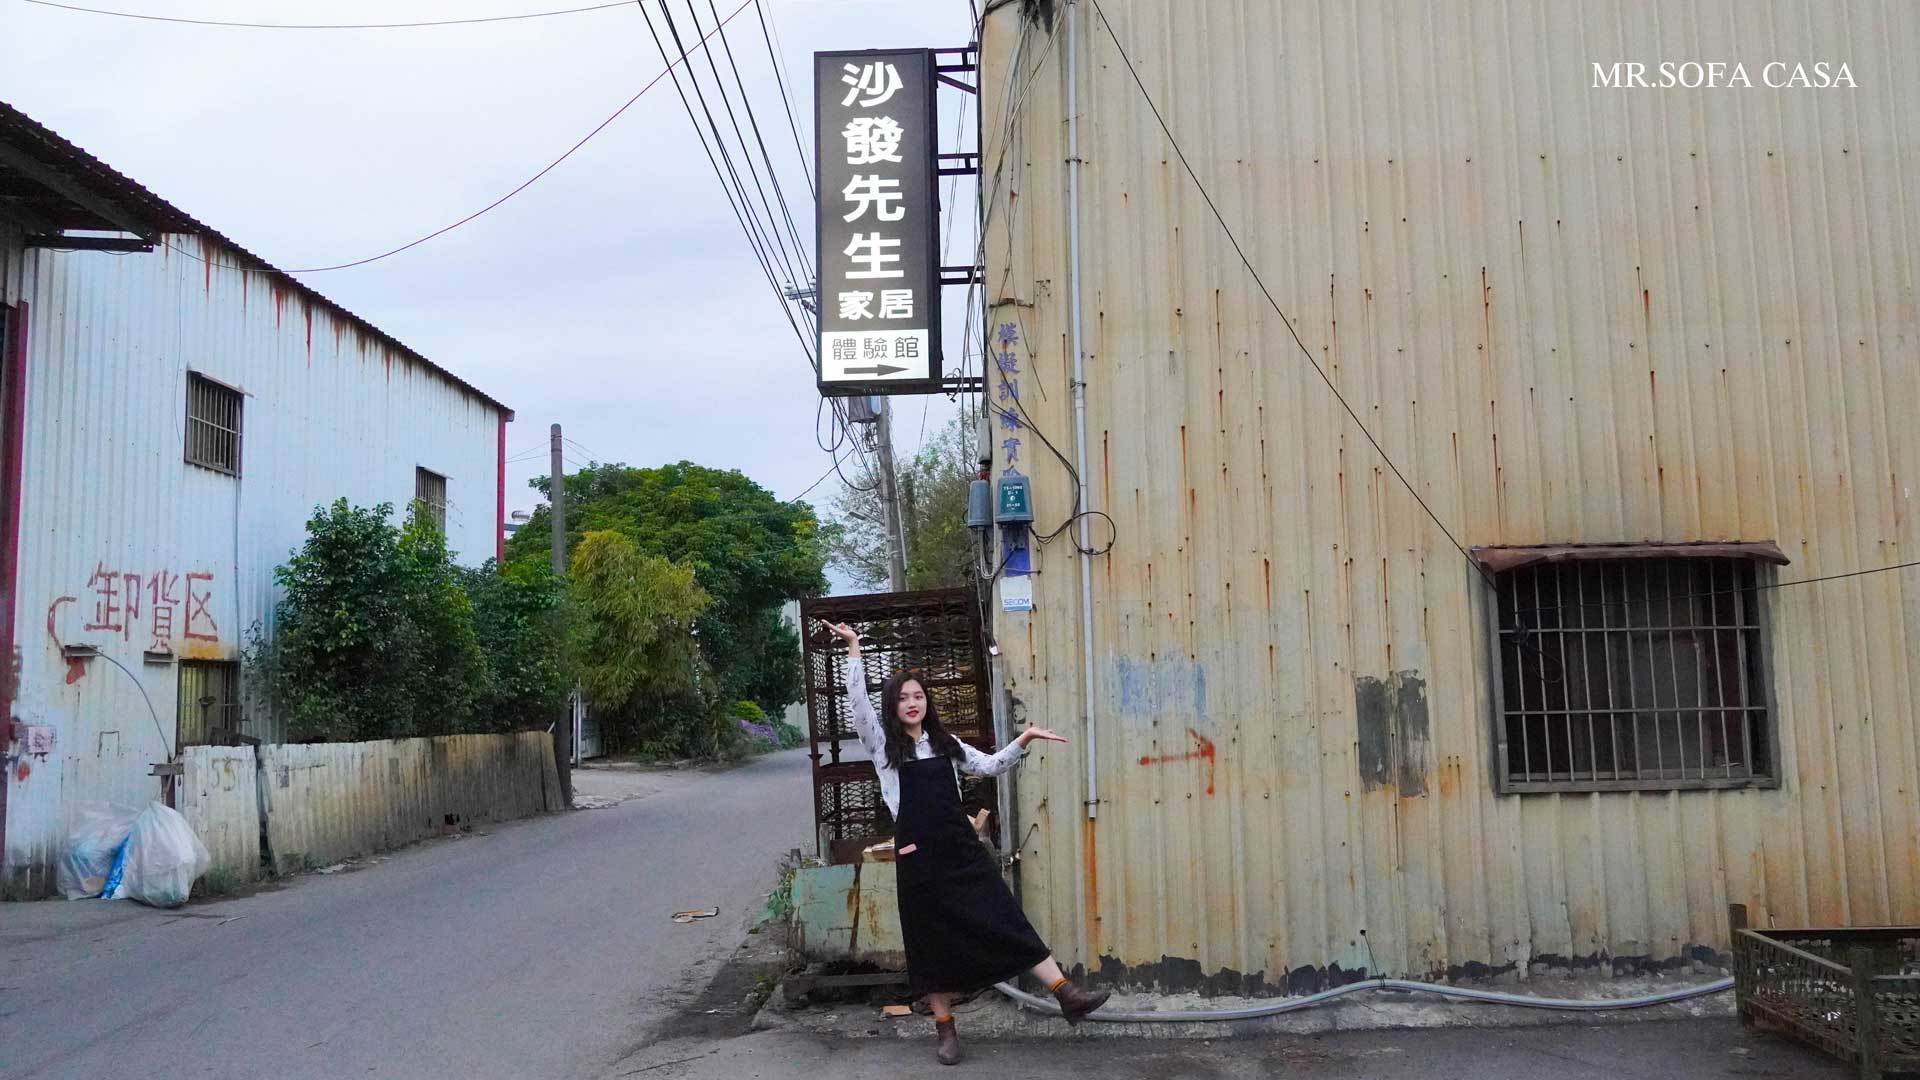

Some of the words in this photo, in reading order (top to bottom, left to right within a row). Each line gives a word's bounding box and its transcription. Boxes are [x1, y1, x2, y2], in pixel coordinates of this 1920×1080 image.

[841, 61, 905, 280] 沙發先生
[838, 289, 914, 320] 家居
[832, 335, 919, 362] 體驗館
[1004, 598, 1030, 606] SECOM
